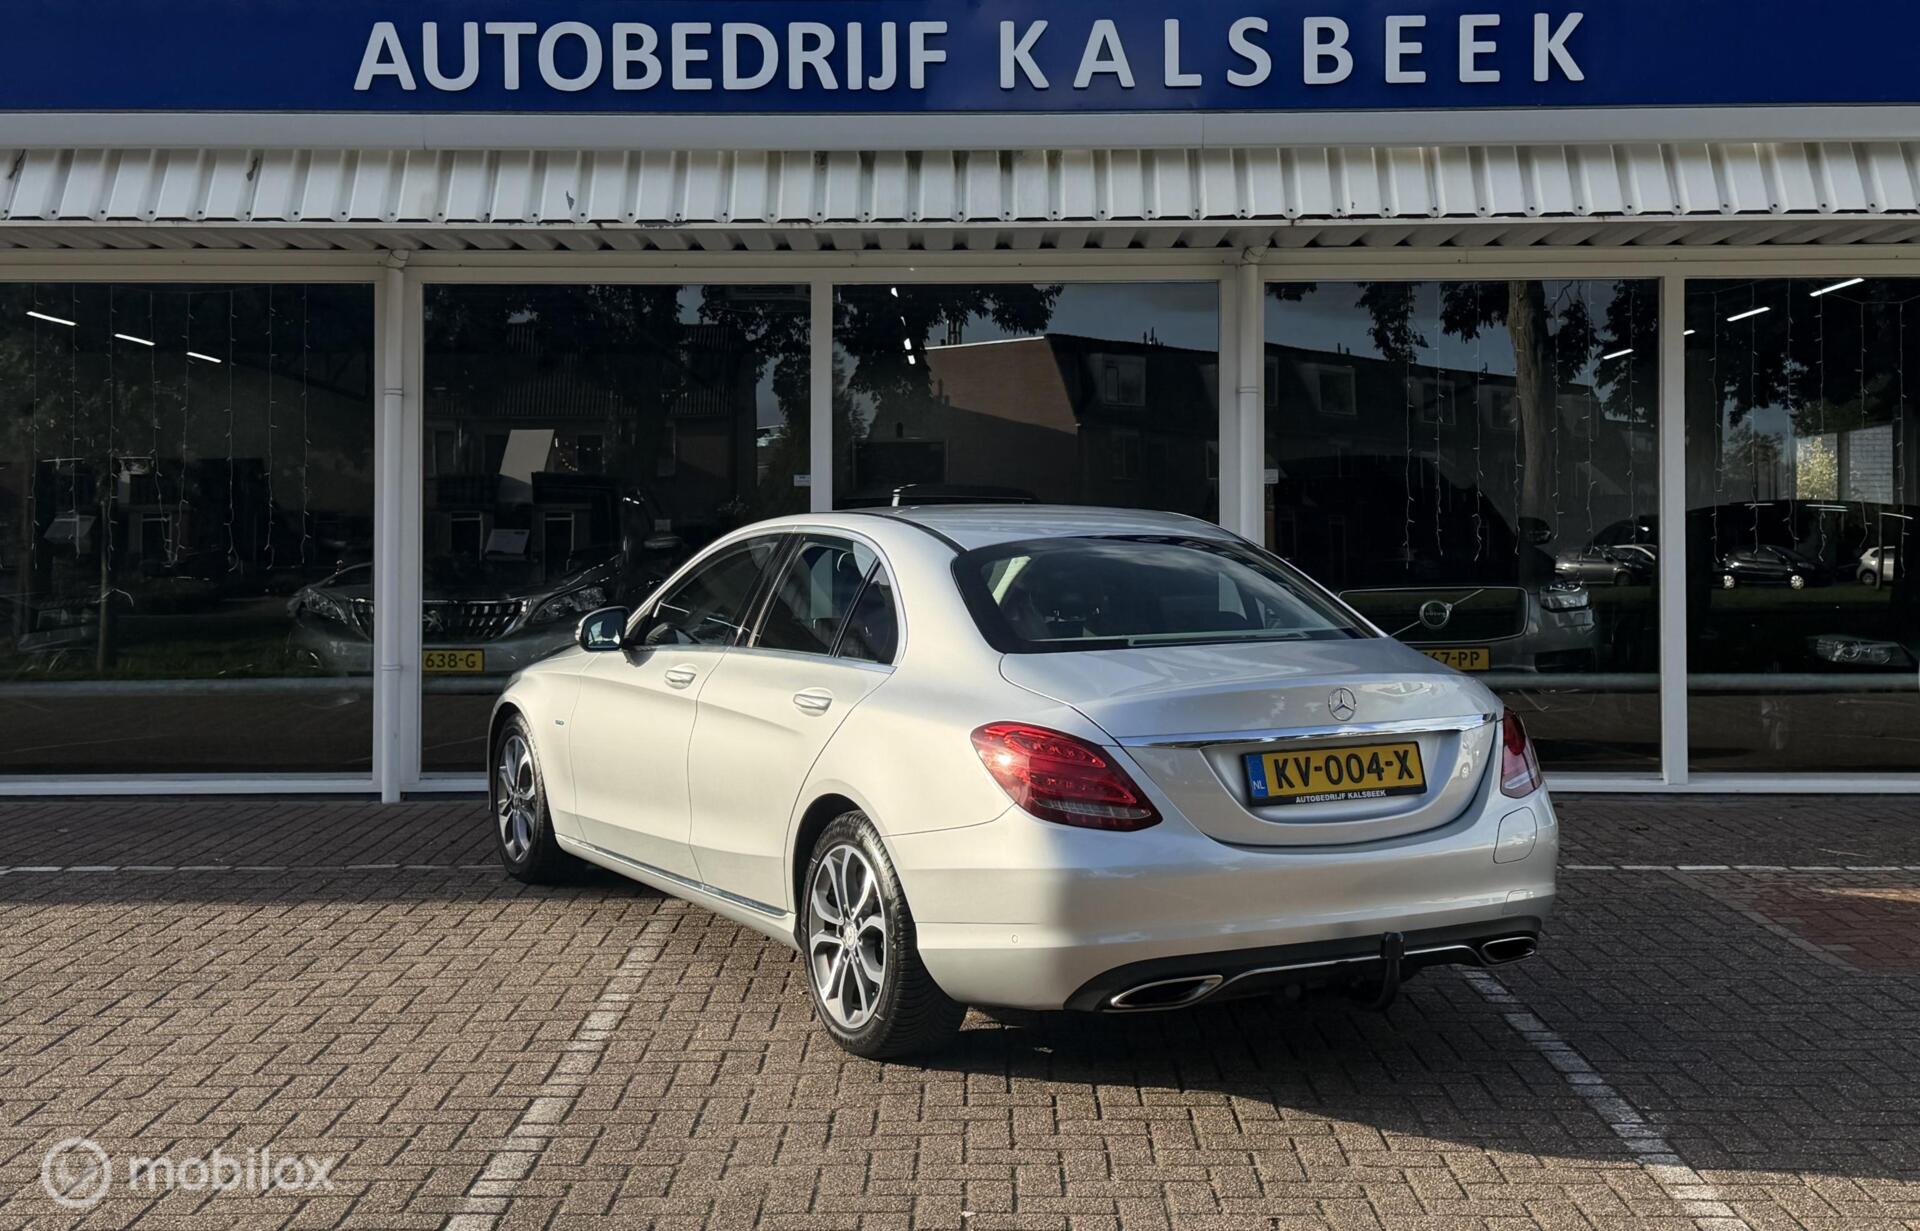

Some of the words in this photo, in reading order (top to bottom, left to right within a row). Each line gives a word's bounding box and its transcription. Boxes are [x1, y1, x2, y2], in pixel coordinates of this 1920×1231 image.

[353, 21, 948, 91] AUTOBEDRIJF
[999, 12, 1585, 89] KALSBEEK
[424, 652, 477, 669] 638-G
[1272, 749, 1415, 790] KV-004-X
[1252, 780, 1265, 791] NL
[1295, 792, 1346, 804] AUTOBEDRIJF
[1347, 789, 1387, 800] KALSBEEK
